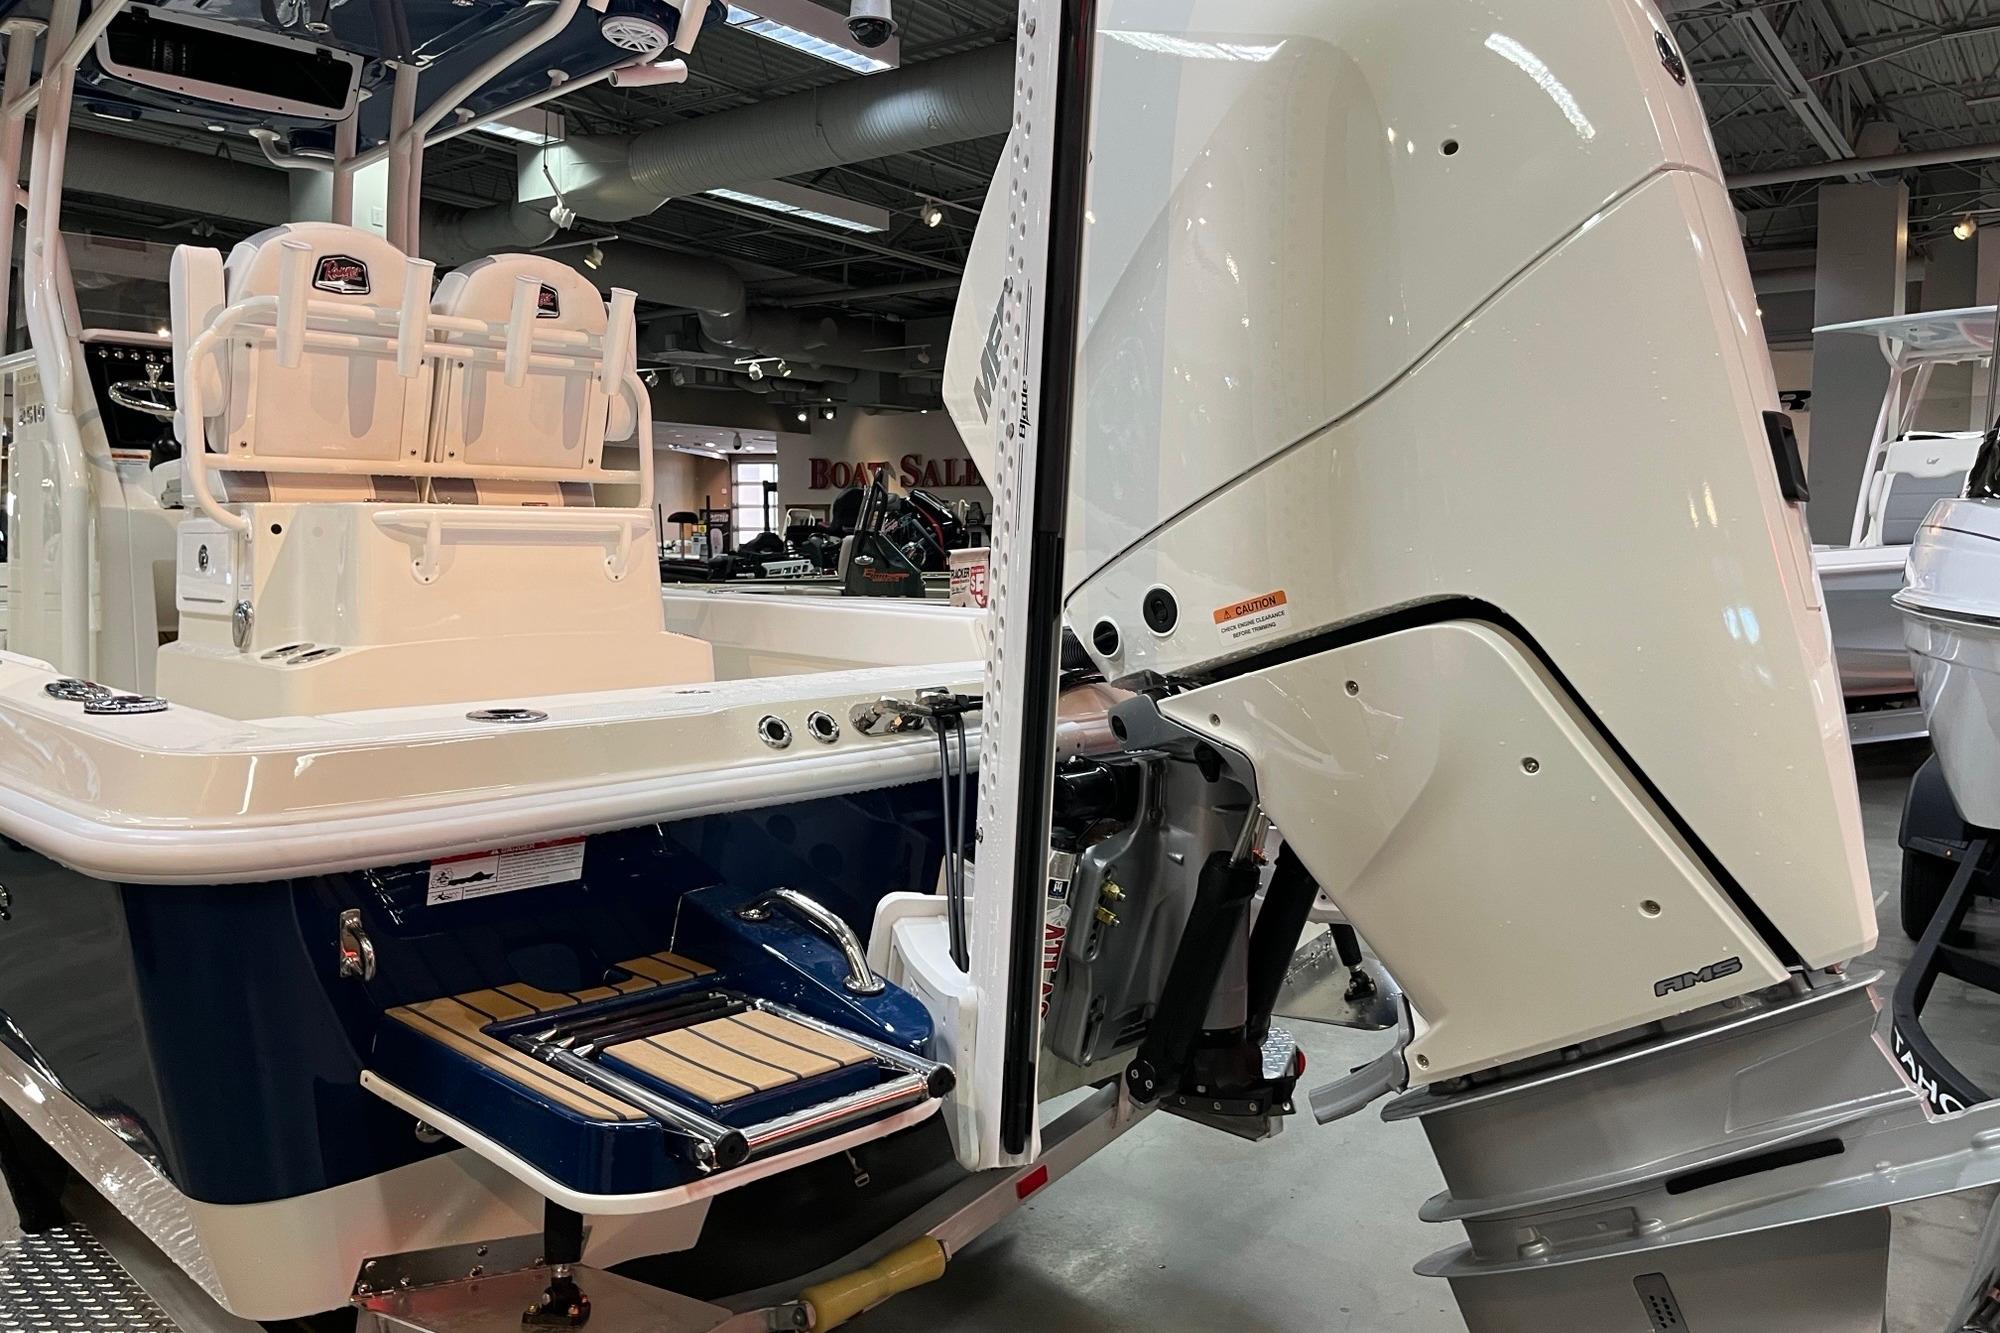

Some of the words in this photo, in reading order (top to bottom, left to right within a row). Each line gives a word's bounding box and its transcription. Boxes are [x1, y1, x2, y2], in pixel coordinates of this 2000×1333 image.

[1018, 379, 1032, 440] Blade
[1236, 595, 1276, 615] CAUTION
[1221, 624, 1236, 633] CHECK
[1237, 618, 1255, 629] ENGINE
[1255, 611, 1285, 623] CLEARANCE
[1232, 629, 1252, 639] BEFORE
[1251, 621, 1277, 633] TRIMMING
[1653, 956, 1743, 997] AMS
